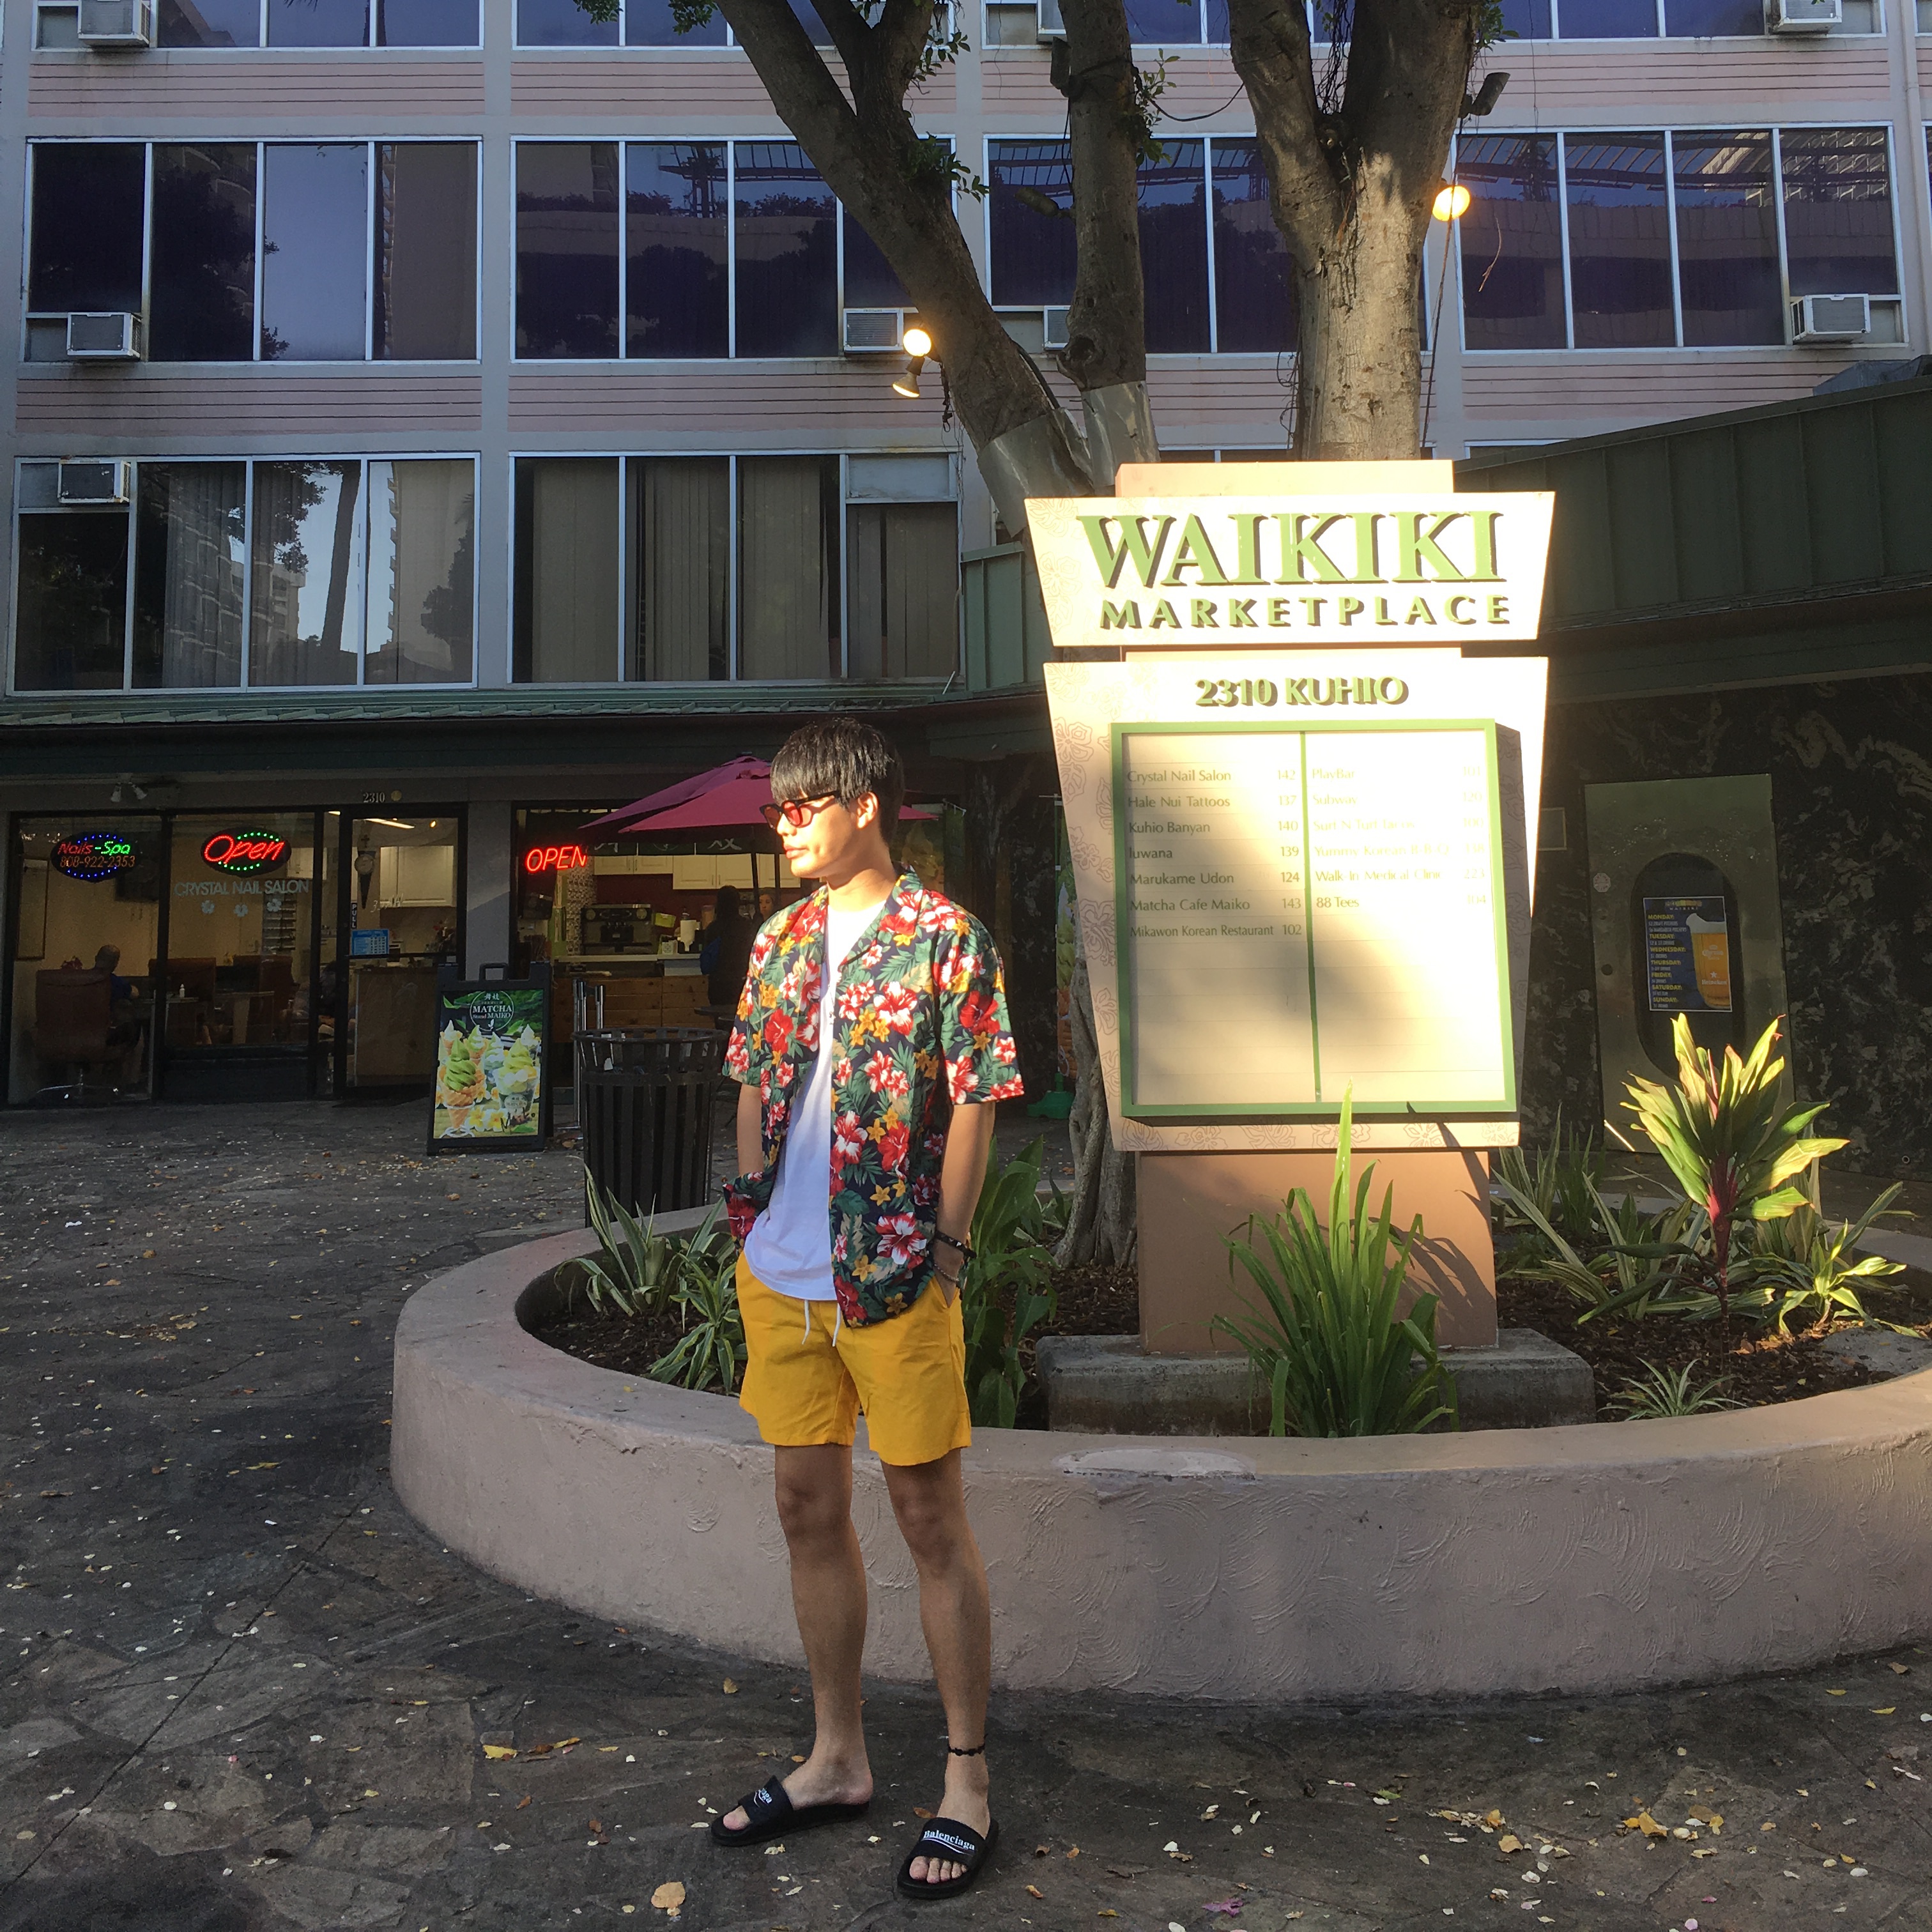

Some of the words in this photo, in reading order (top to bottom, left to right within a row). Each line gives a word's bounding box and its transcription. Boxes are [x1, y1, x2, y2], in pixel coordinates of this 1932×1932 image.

[1076, 512, 1506, 587] WAIKIKI
[1100, 595, 1509, 629] MARKETPLACE
[1195, 677, 1277, 707] 2310
[1285, 676, 1409, 705] KUHIO
[1127, 770, 1167, 785] Crystal
[1171, 769, 1195, 781] Nail
[1199, 769, 1231, 781] Salon
[1278, 769, 1296, 780] 142
[1312, 767, 1355, 781] PlayBar
[363, 792, 385, 803] 2310
[1128, 795, 1156, 808] Hale
[1160, 795, 1181, 807] Nui
[1186, 795, 1230, 807] Tattoos
[1278, 795, 1296, 806] 137
[1313, 793, 1358, 806] Subway
[1129, 821, 1163, 833] Kuhio
[1168, 822, 1210, 836] Banyan
[1278, 820, 1298, 831] 140
[204, 835, 286, 865] Open
[1280, 846, 1300, 857] 139
[526, 845, 587, 873] OPEN
[1130, 872, 1196, 885] Marukame
[1200, 872, 1234, 884] Udon
[1281, 871, 1300, 883] 124
[1365, 869, 1409, 880] Medical
[1464, 868, 1485, 880] 223
[173, 882, 229, 896] CRYSTAL
[233, 881, 262, 894] NAIL
[264, 880, 309, 894] SALON
[1130, 898, 1175, 911] Matcha
[1179, 898, 1208, 910] Cafe
[1211, 898, 1250, 910] Maiko
[1282, 898, 1301, 909] 143
[1316, 896, 1331, 908] 88
[1334, 896, 1360, 907] Tees
[1130, 924, 1178, 937] Mikawon
[1182, 925, 1217, 936] Korean
[1222, 924, 1274, 936] Restaurant
[1282, 924, 1302, 935] 102
[473, 1005, 512, 1013] MATCHA
[923, 1830, 975, 1851] Balenciaga
